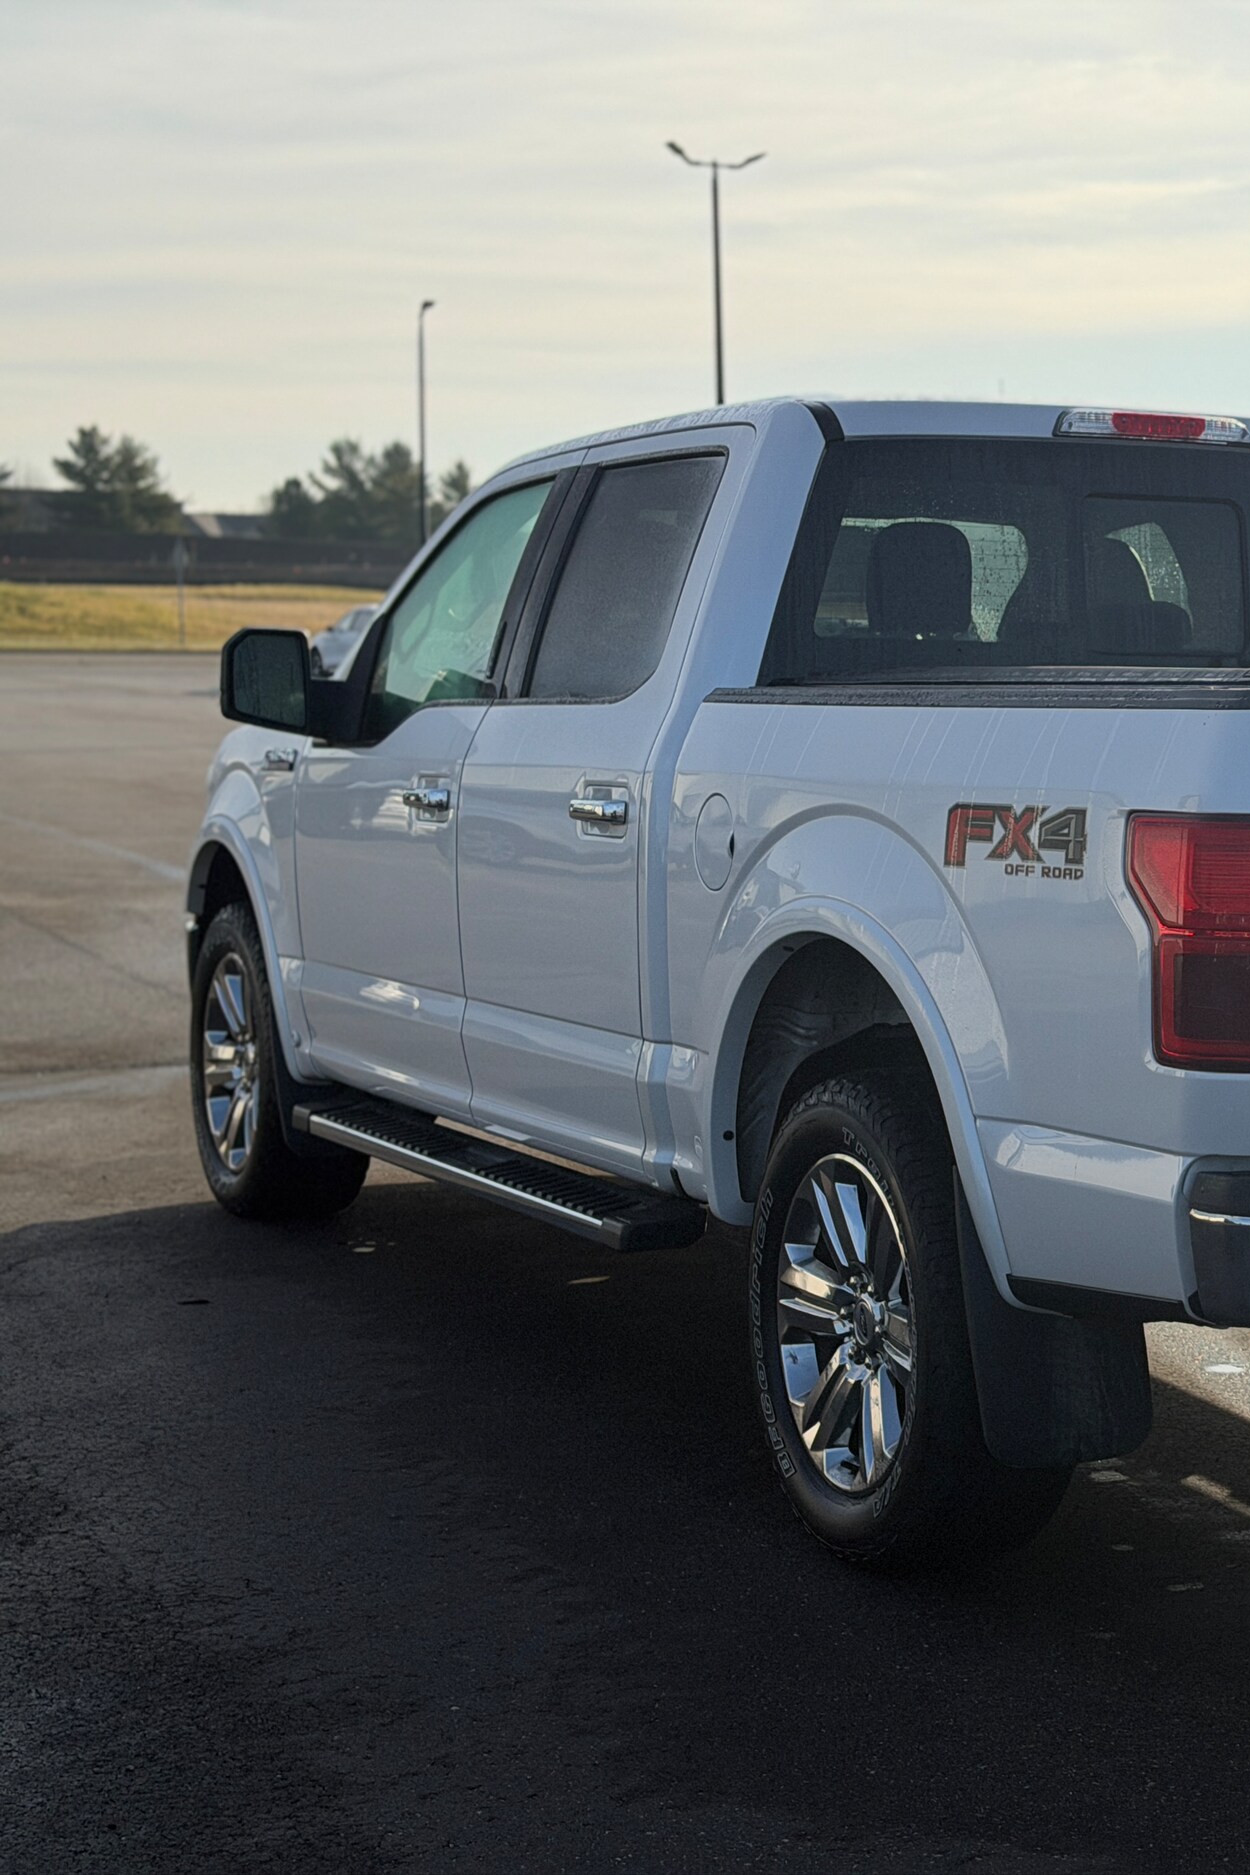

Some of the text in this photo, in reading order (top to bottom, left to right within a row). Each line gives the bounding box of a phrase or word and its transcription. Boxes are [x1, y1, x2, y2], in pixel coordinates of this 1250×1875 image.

[944, 802, 1087, 868] FX4
[1004, 863, 1084, 880] OFF ROAD
